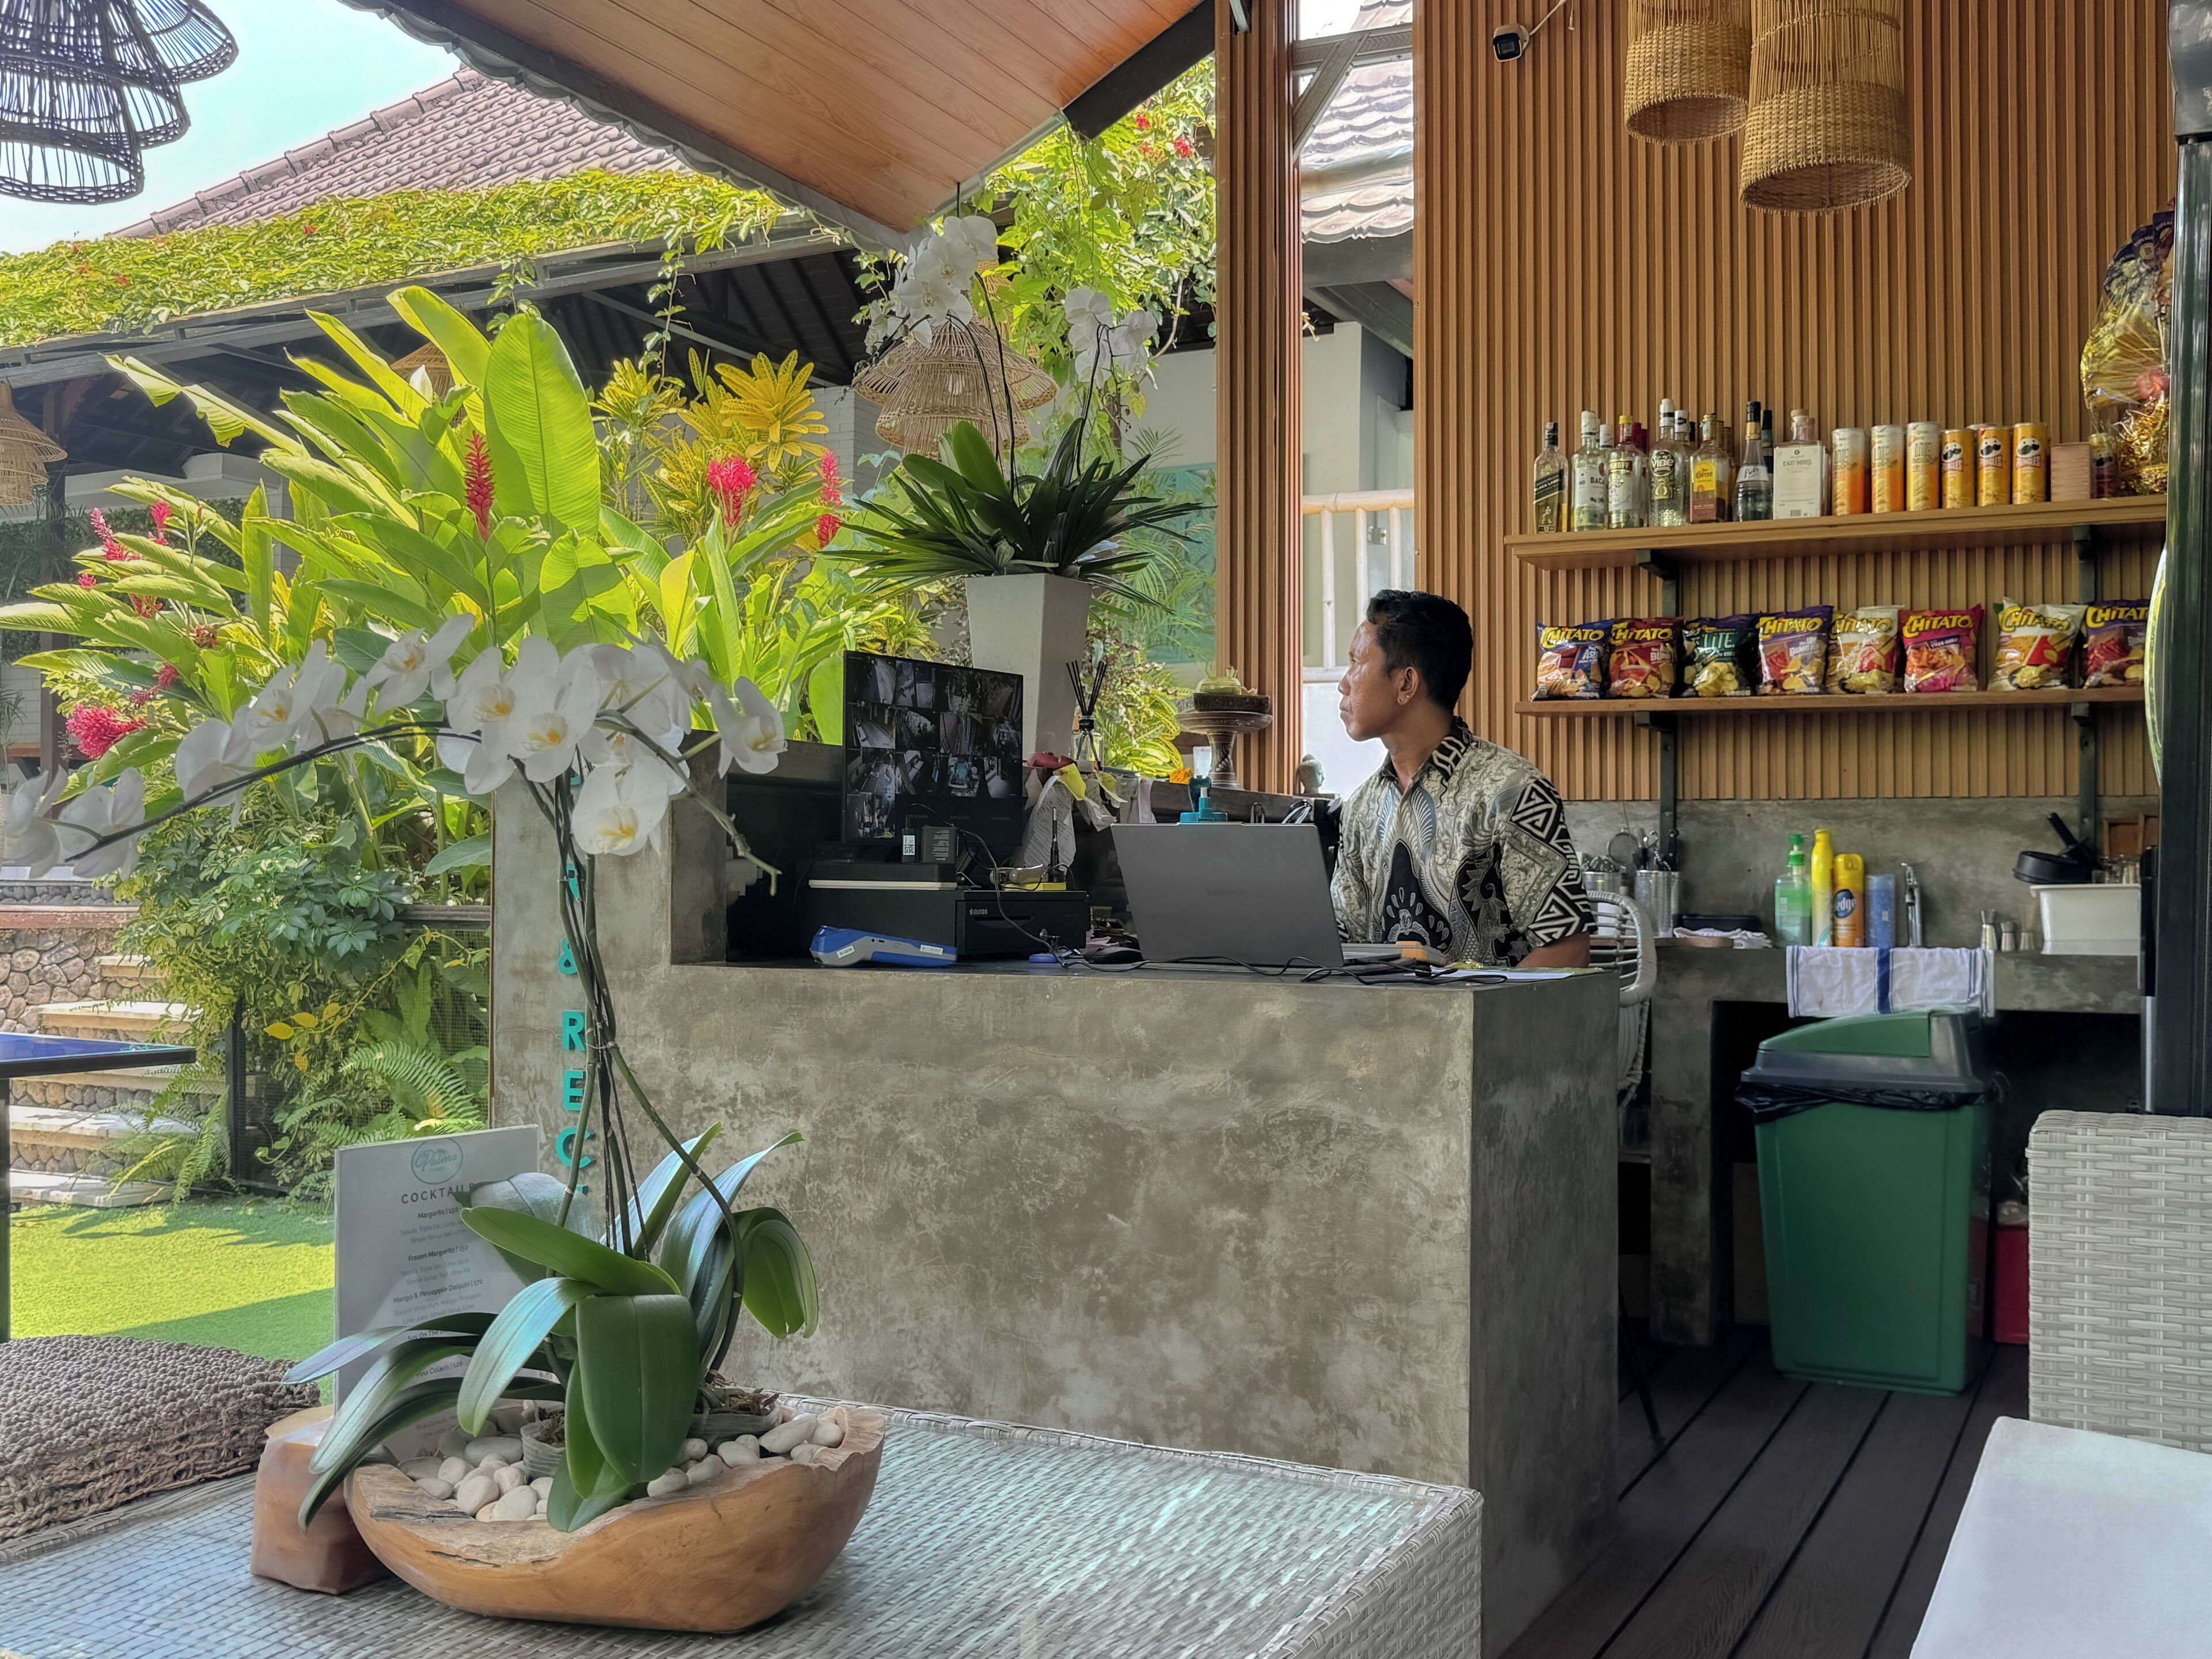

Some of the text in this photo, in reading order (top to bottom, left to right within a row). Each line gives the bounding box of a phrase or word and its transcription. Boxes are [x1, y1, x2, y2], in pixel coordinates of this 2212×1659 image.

[1756, 616, 1823, 639] CHiTATO
[1902, 615, 1974, 638] CHiTATO
[2086, 607, 2149, 628] CHiTAT
[1540, 627, 1605, 649] CHiTATO
[1611, 622, 1673, 646] CHiTATO
[1835, 896, 1857, 912] edge
[418, 1209, 445, 1219] Margarita
[428, 1247, 455, 1258] Margarita
[393, 1295, 413, 1304] Mango
[419, 1287, 448, 1298] Pineapple
[449, 1281, 469, 1291] Daiquiri
[429, 1365, 449, 1374] Colada
